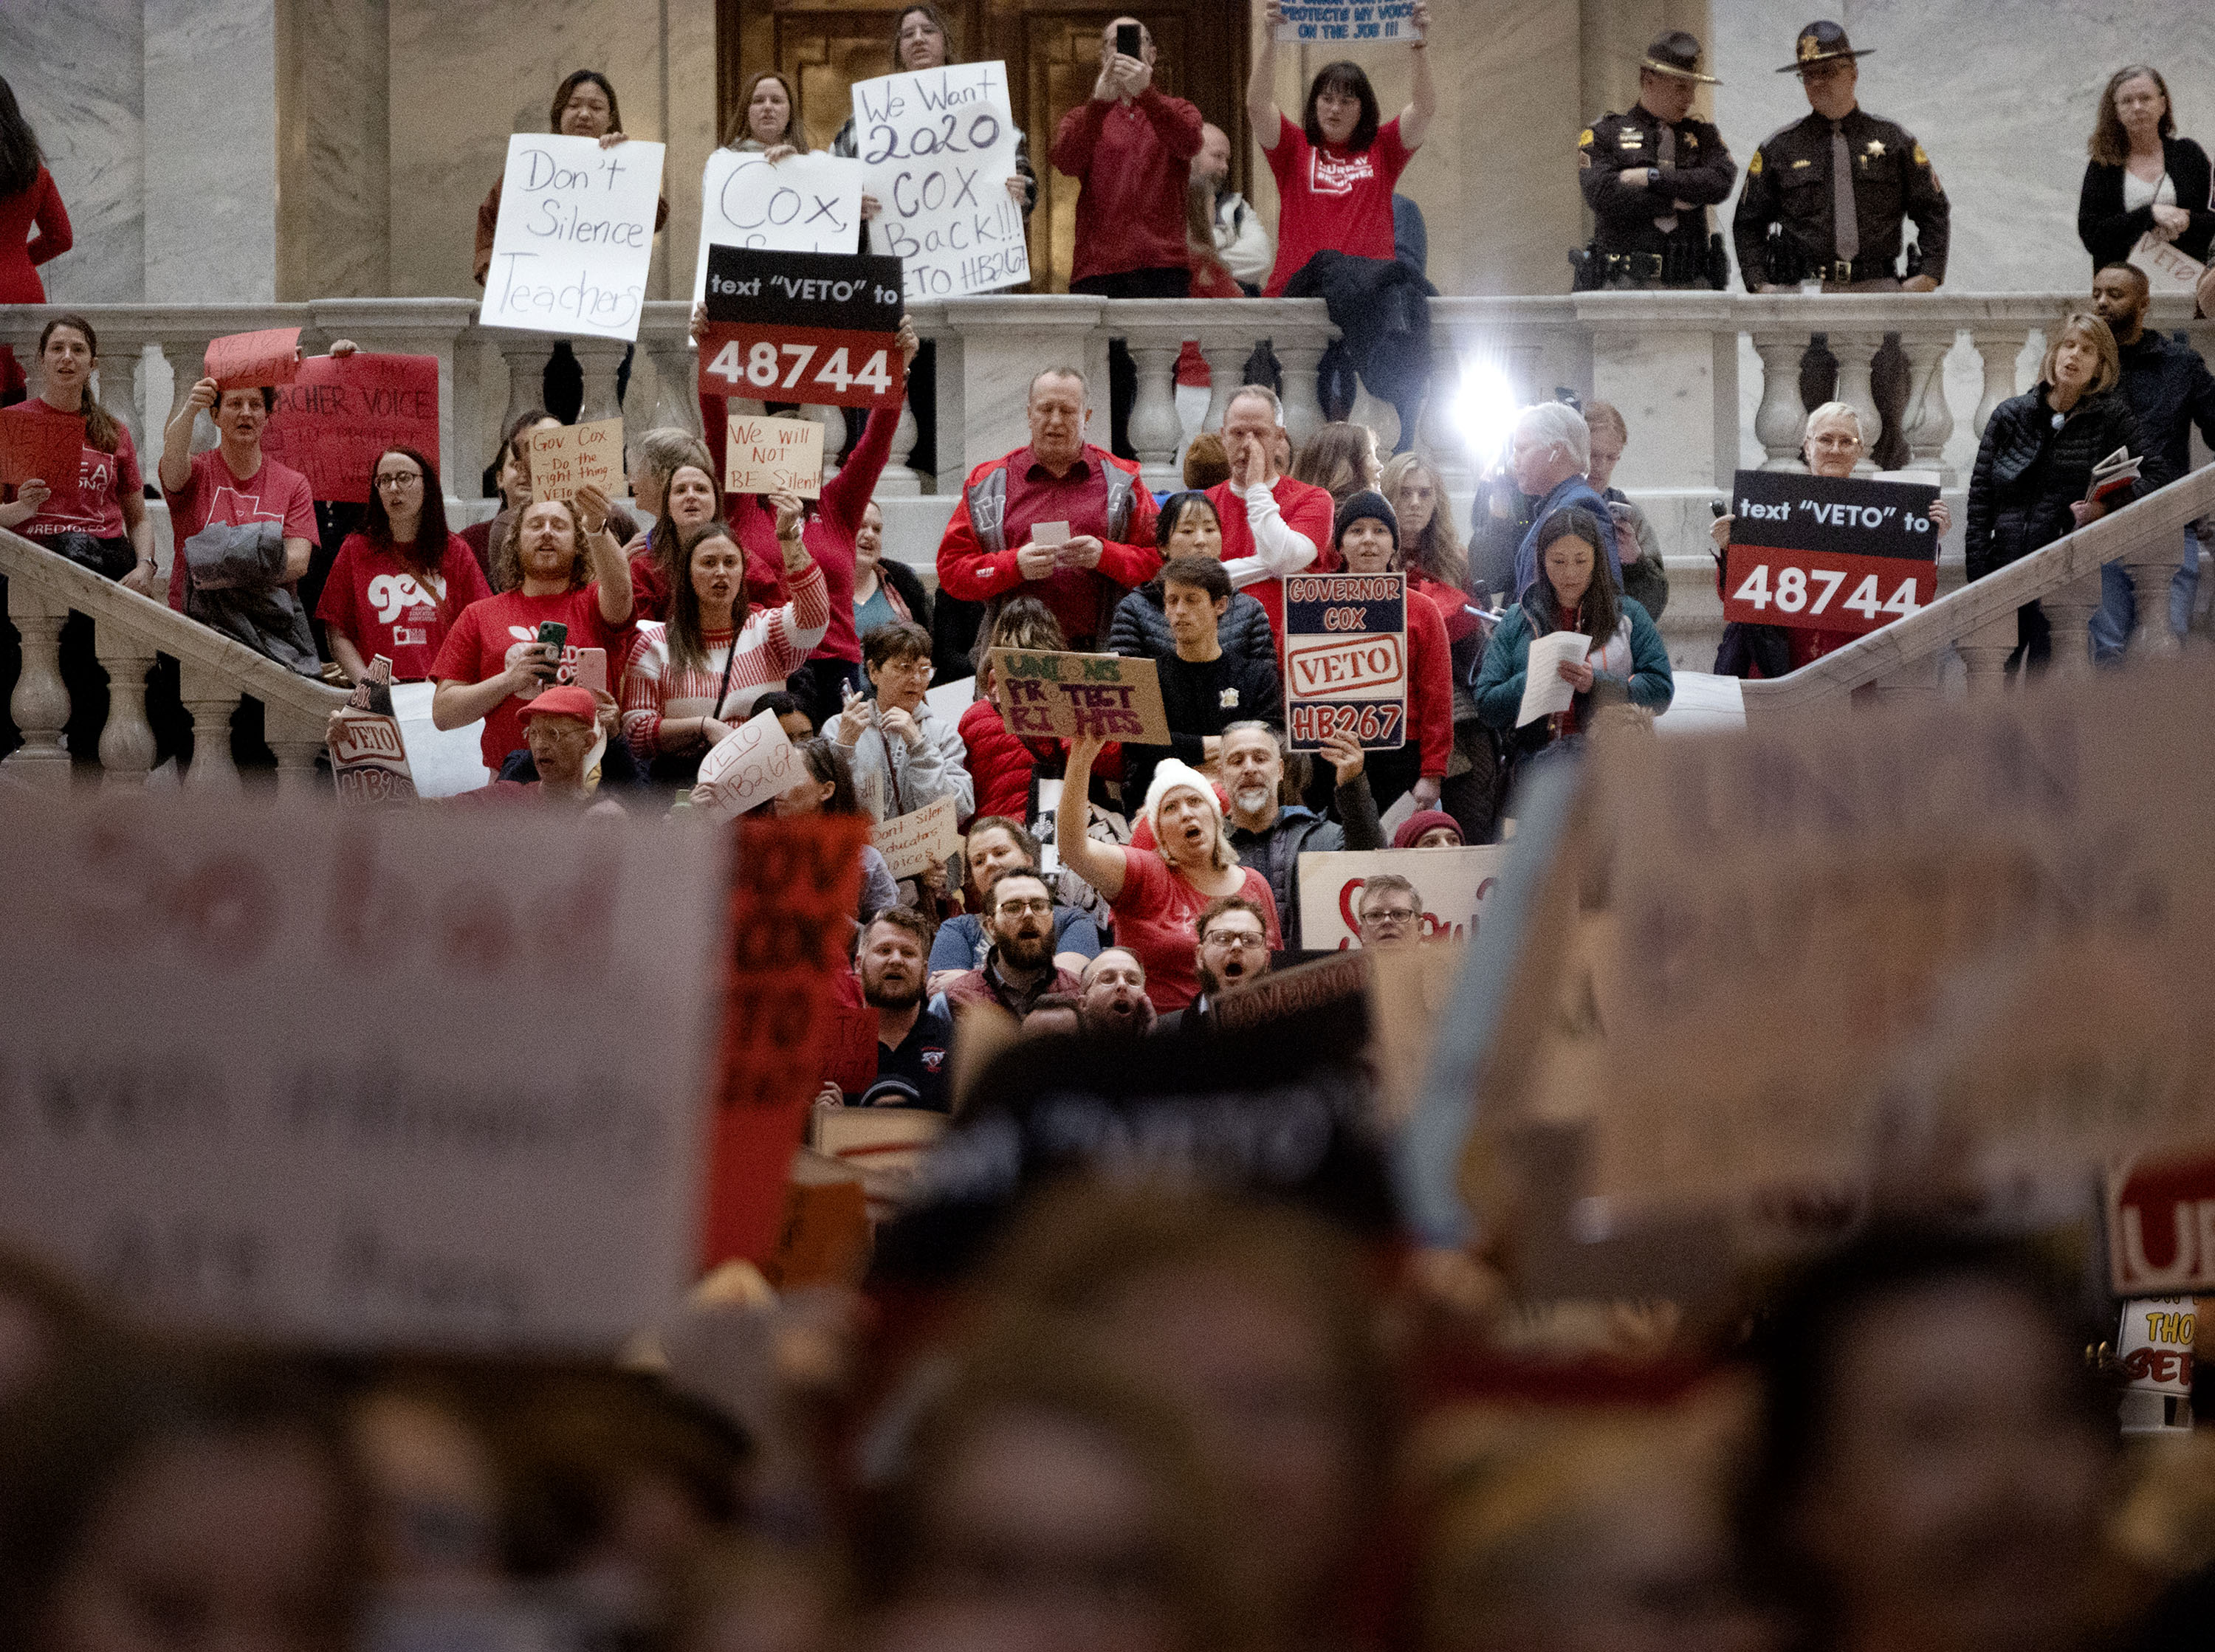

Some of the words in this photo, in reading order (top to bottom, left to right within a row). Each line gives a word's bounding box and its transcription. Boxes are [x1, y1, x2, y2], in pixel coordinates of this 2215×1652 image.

[1298, 24, 1317, 38] ON
[1322, 24, 1349, 39] THE
[1353, 22, 1380, 38] JOB
[1354, 7, 1374, 21] MY
[862, 80, 904, 123] We
[915, 69, 997, 111] Want
[865, 114, 999, 165] 2020
[520, 150, 626, 191] Don't
[893, 167, 978, 217] COX
[527, 199, 643, 248] Silence
[961, 245, 1026, 289] HB267
[500, 252, 641, 328] Teachers
[712, 274, 761, 296] text
[875, 284, 898, 304] to
[706, 340, 892, 394] 48744
[361, 388, 437, 419] VOICE
[533, 432, 565, 451] Gov
[578, 427, 607, 446] Cox
[729, 421, 763, 444] We
[779, 427, 809, 444] will
[574, 452, 597, 465] the
[752, 447, 791, 464] NOT
[537, 470, 573, 487] right
[732, 470, 759, 489] BE
[1740, 498, 1791, 520] text
[1904, 512, 1929, 532] to
[1290, 577, 1400, 602] GOVERNOR
[1733, 565, 1921, 619] 48744
[1325, 608, 1367, 630] COX
[1298, 647, 1391, 685] VETO
[348, 726, 395, 751] VETO
[1293, 705, 1402, 740] HB267
[703, 725, 761, 775] VETO
[707, 743, 792, 810] HB267
